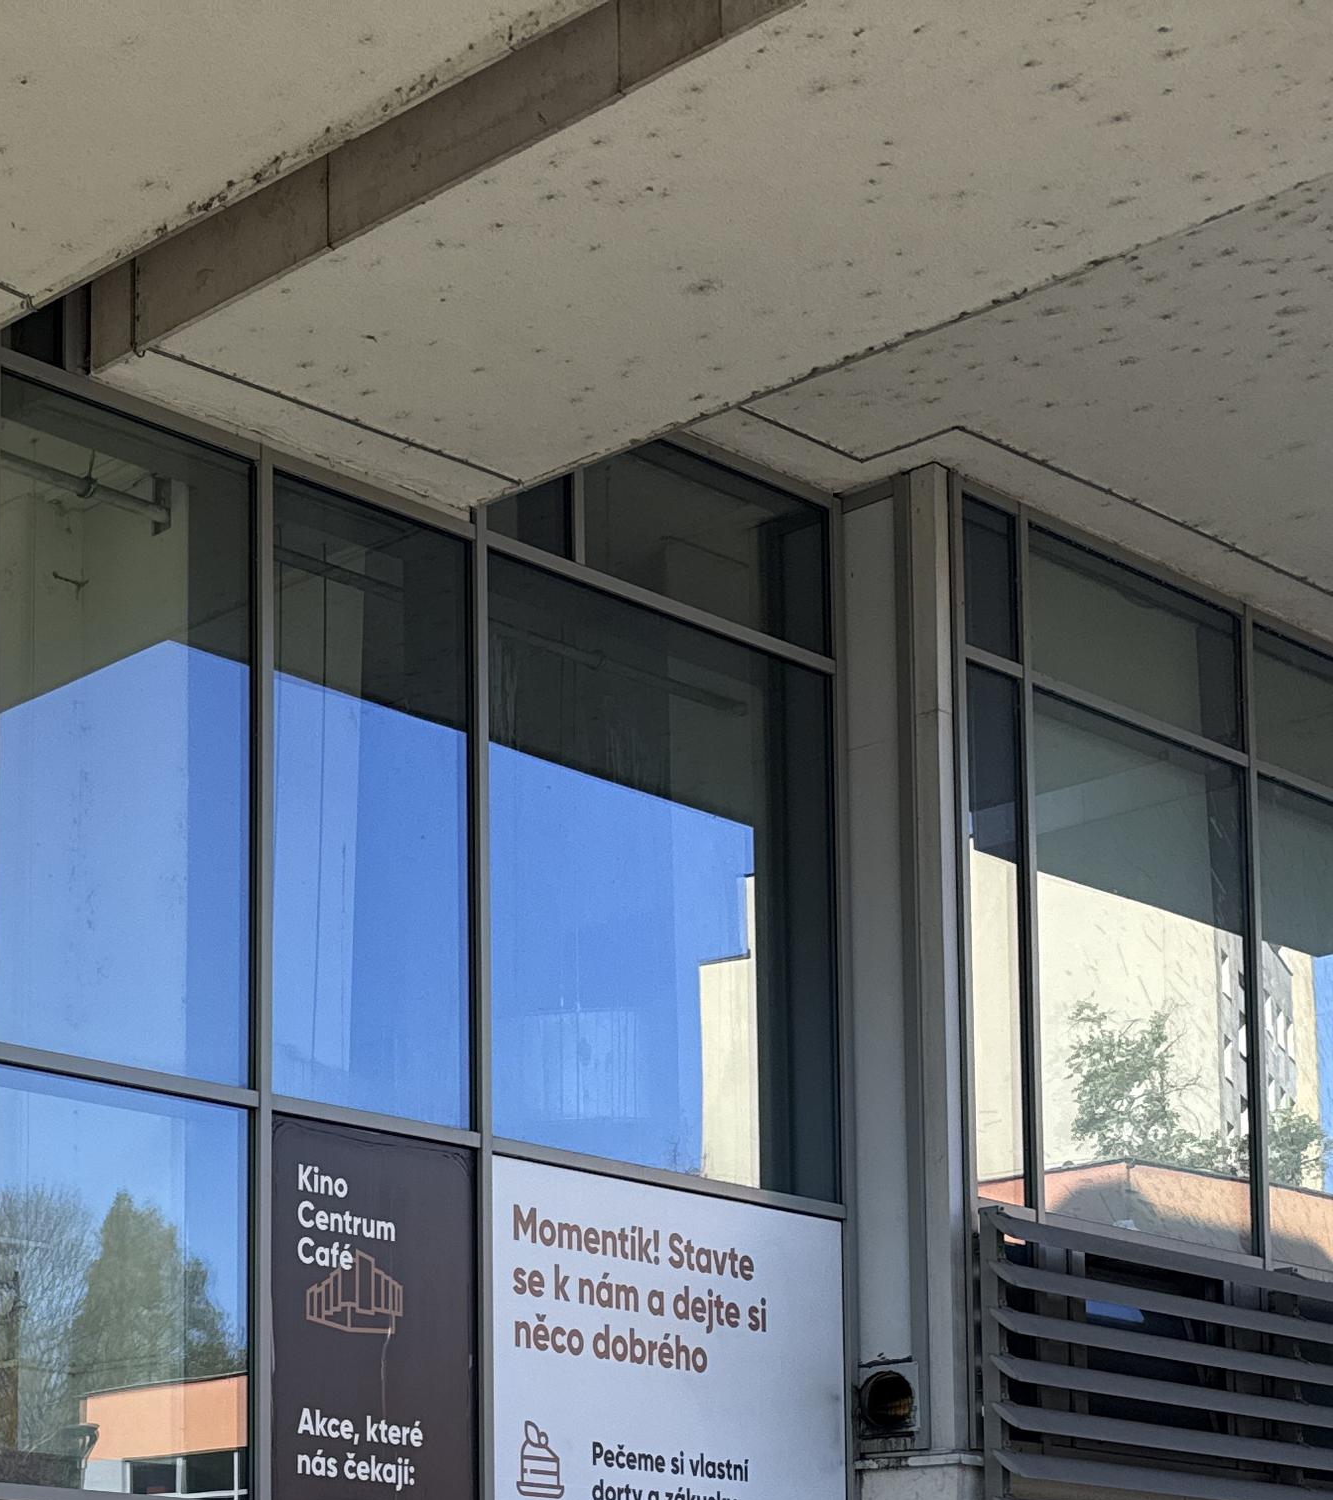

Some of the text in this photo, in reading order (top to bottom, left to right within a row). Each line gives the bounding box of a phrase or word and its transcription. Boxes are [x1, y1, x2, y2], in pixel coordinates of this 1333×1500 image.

[297, 1164, 348, 1198] Kino
[297, 1201, 396, 1242] Centrum
[513, 1203, 755, 1281] Momentík! Stavte
[297, 1236, 354, 1271] Café
[513, 1264, 766, 1335] se k nám a dejte si
[515, 1314, 708, 1373] něco dobrého
[297, 1408, 423, 1448] Akce, které
[297, 1447, 415, 1491] nás čekají:
[591, 1442, 749, 1482] Pečeme si vlastní
